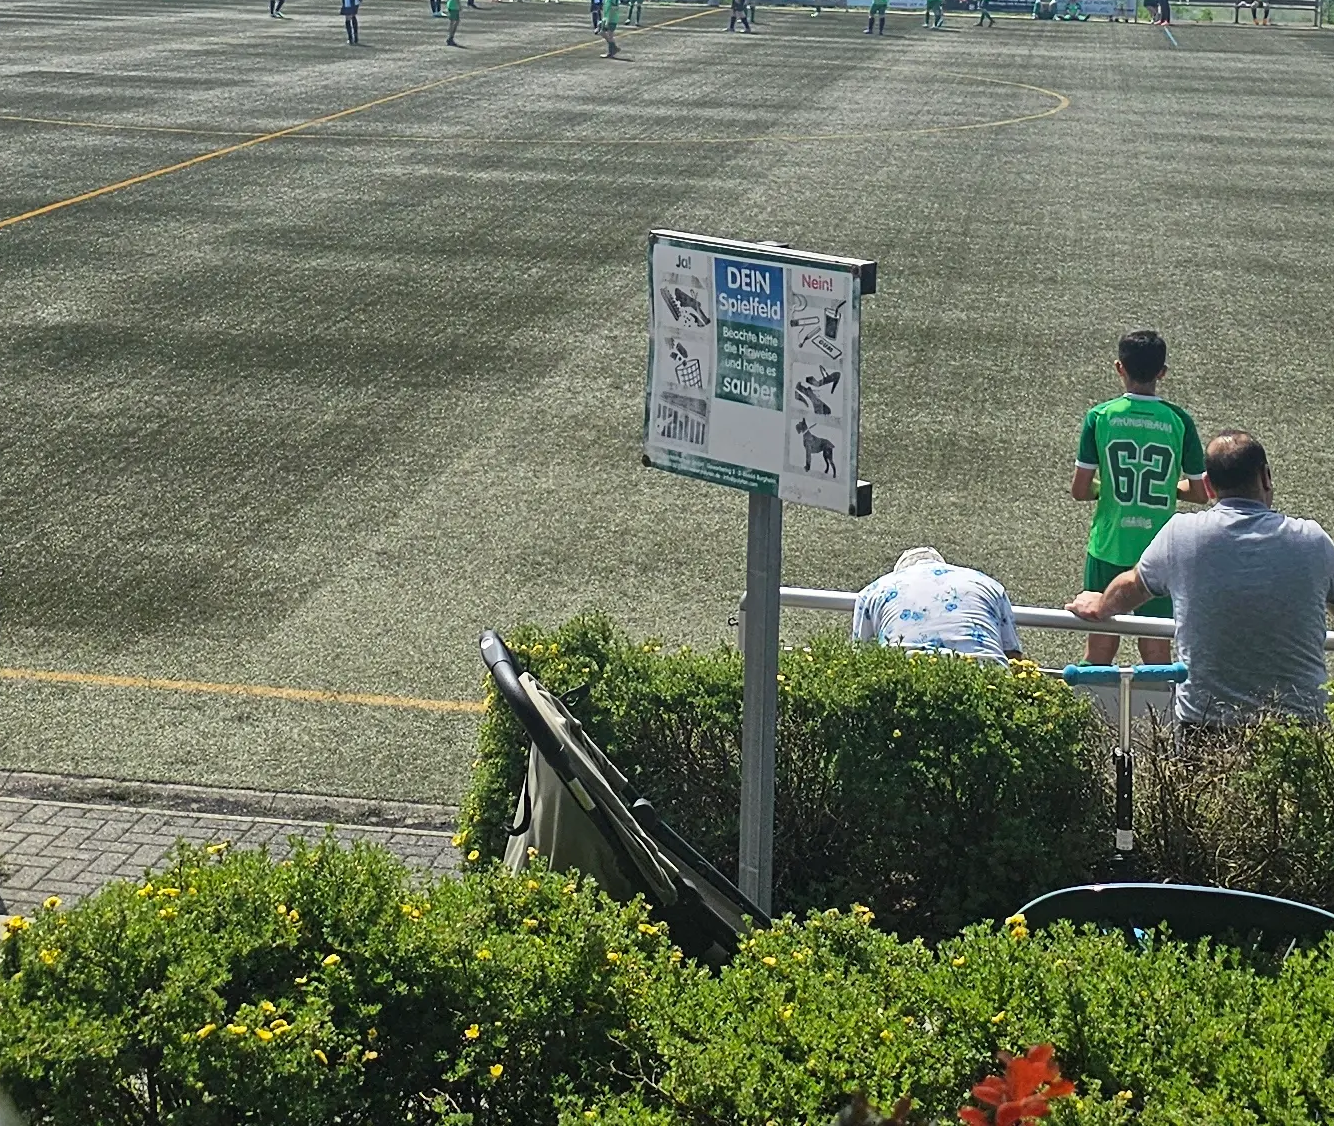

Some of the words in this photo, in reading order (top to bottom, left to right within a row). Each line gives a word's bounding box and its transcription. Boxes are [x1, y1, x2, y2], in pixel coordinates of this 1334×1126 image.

[676, 254, 692, 271] Ja!
[727, 266, 770, 294] DEIN
[801, 274, 833, 292] Nein!
[719, 293, 781, 321] Spielfeld
[722, 326, 757, 343] Beachte
[759, 331, 779, 347] bitte
[818, 338, 835, 353] GUM
[723, 341, 737, 354] die
[738, 346, 778, 362] Hinweise
[724, 357, 742, 370] und
[743, 359, 765, 374] halte
[766, 366, 777, 377] es
[722, 375, 777, 401] sauber
[1105, 439, 1176, 510] 62
